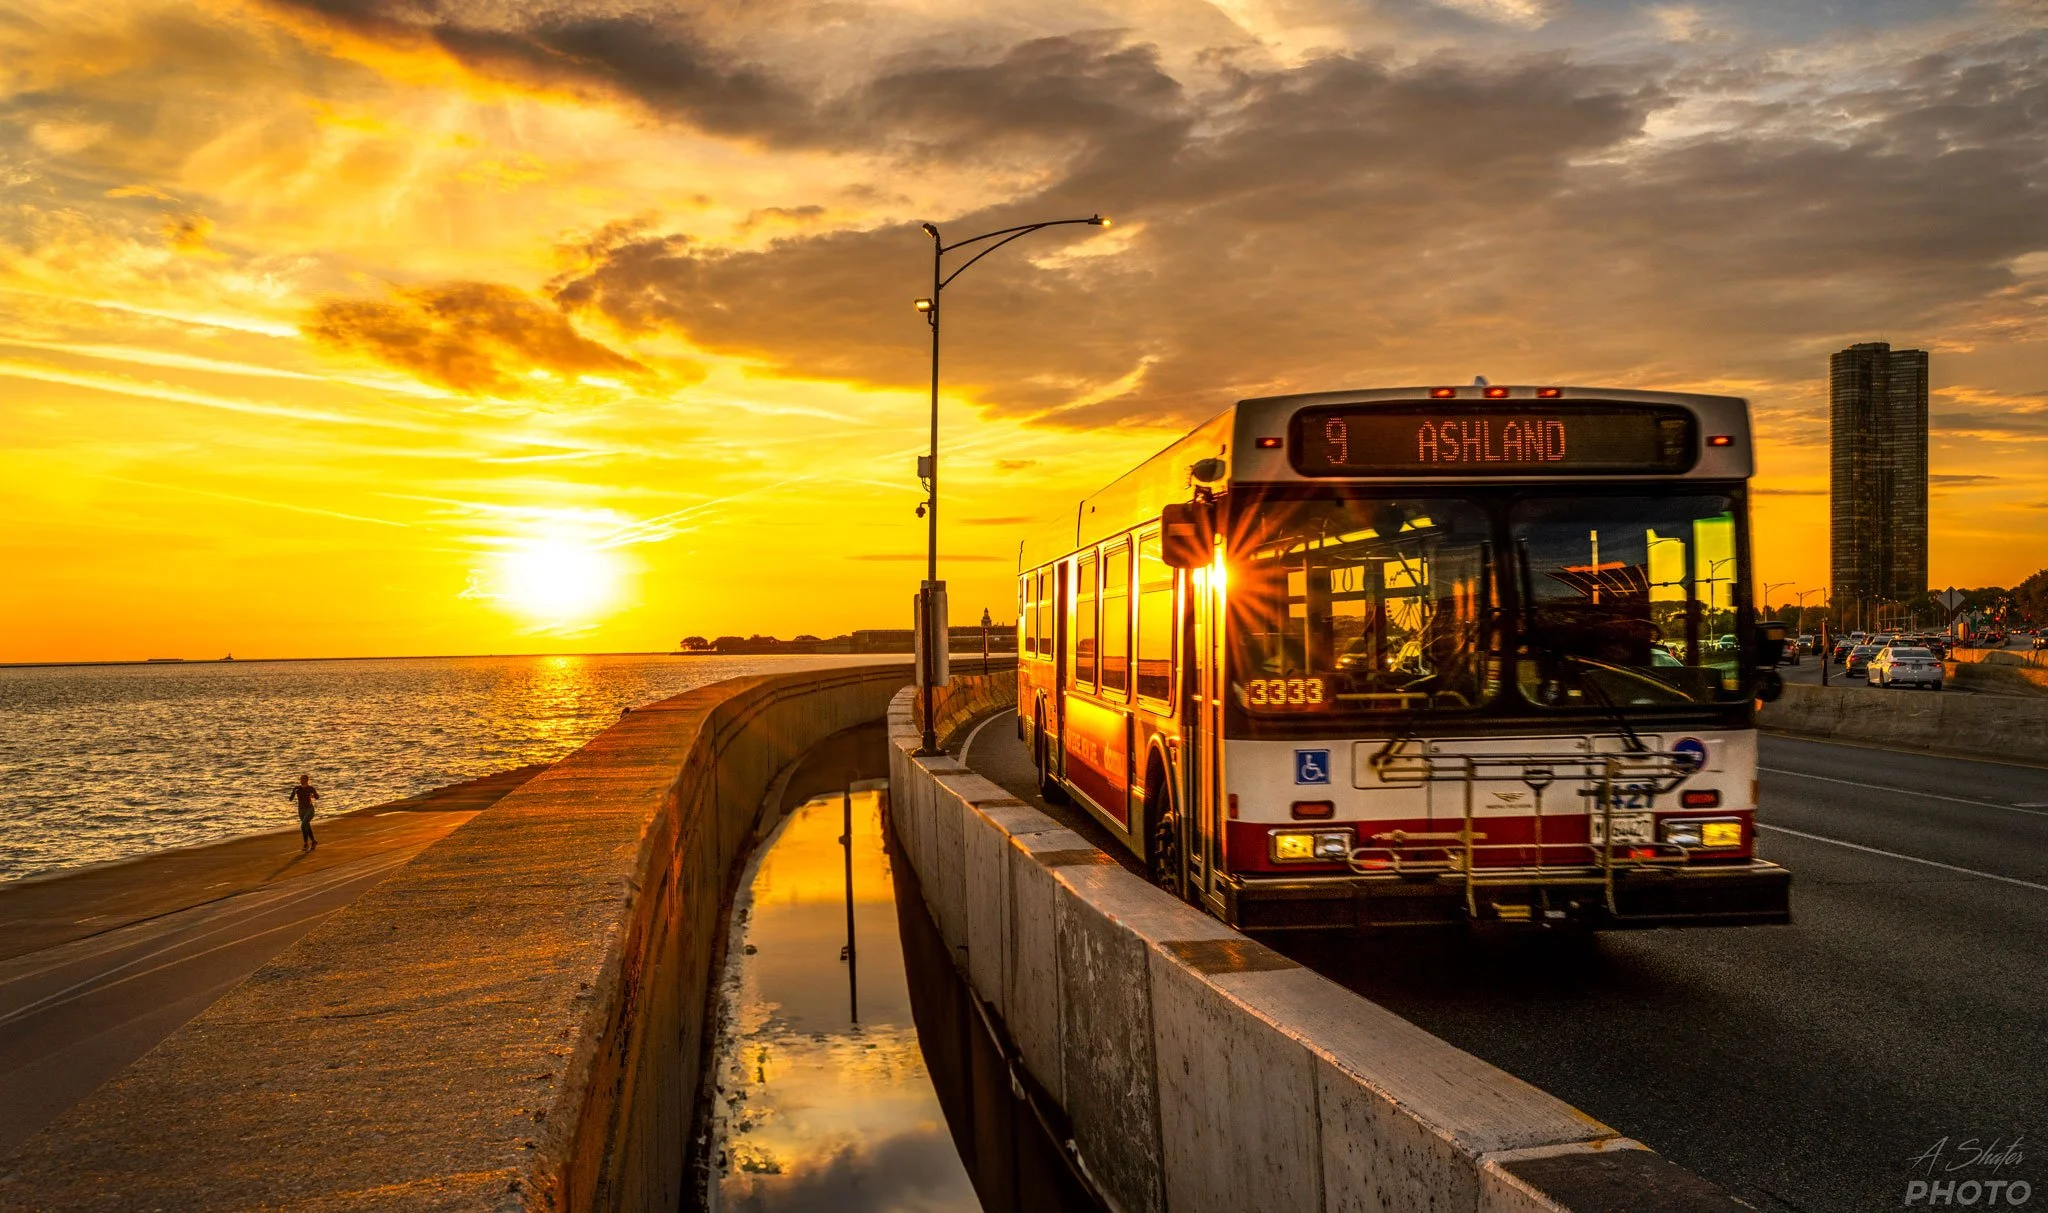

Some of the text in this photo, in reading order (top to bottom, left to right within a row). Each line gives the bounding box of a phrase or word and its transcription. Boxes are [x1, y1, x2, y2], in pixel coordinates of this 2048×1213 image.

[1326, 417, 1566, 464] 9 ASHLAND
[1250, 678, 1324, 704] 3333
